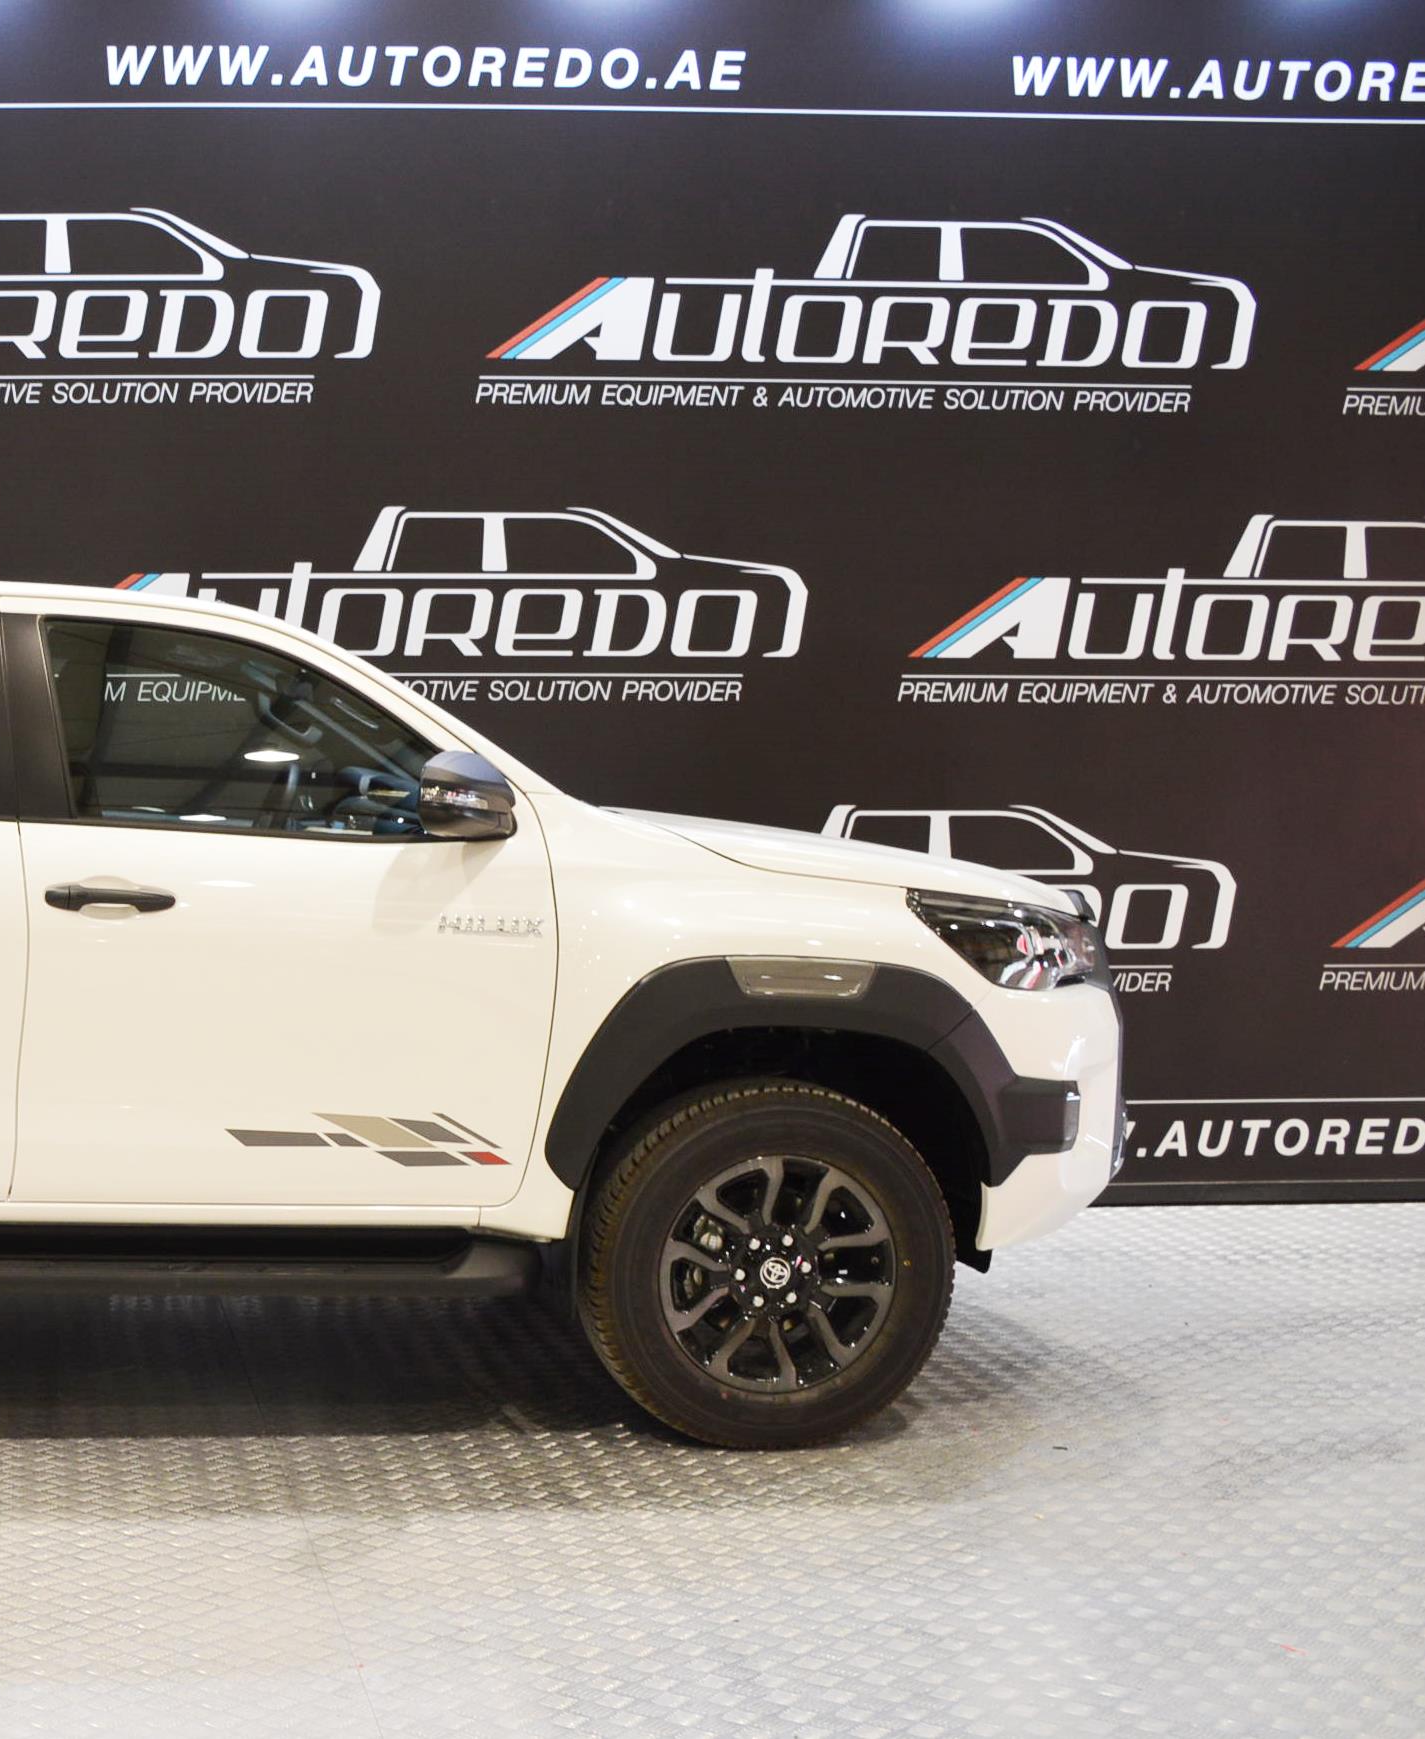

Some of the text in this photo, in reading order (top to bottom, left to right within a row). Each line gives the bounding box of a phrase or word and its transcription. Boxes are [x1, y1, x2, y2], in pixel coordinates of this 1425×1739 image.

[106, 44, 746, 90] WWW.AUTOREDO.AE
[1012, 54, 1425, 102] WWW.AUTORE
[52, 382, 179, 404] SOLUTION
[189, 382, 313, 403] PROVIDER
[476, 384, 1190, 412] PREMIUM EQUIPMENT & AUTOMOTIVE SOLUTION PROVIDER
[401, 680, 742, 702] OTIVE SOLUTION PROVIDER
[898, 682, 1008, 702] PREMIUM
[1018, 683, 1154, 704] EQUIPMENT
[1163, 684, 1176, 704] &
[1187, 684, 1337, 704] AUTOMOTIVE
[437, 912, 544, 938] HILUX
[1320, 971, 1425, 990] PREMIUM
[1126, 1117, 1425, 1160] .AUTORED
